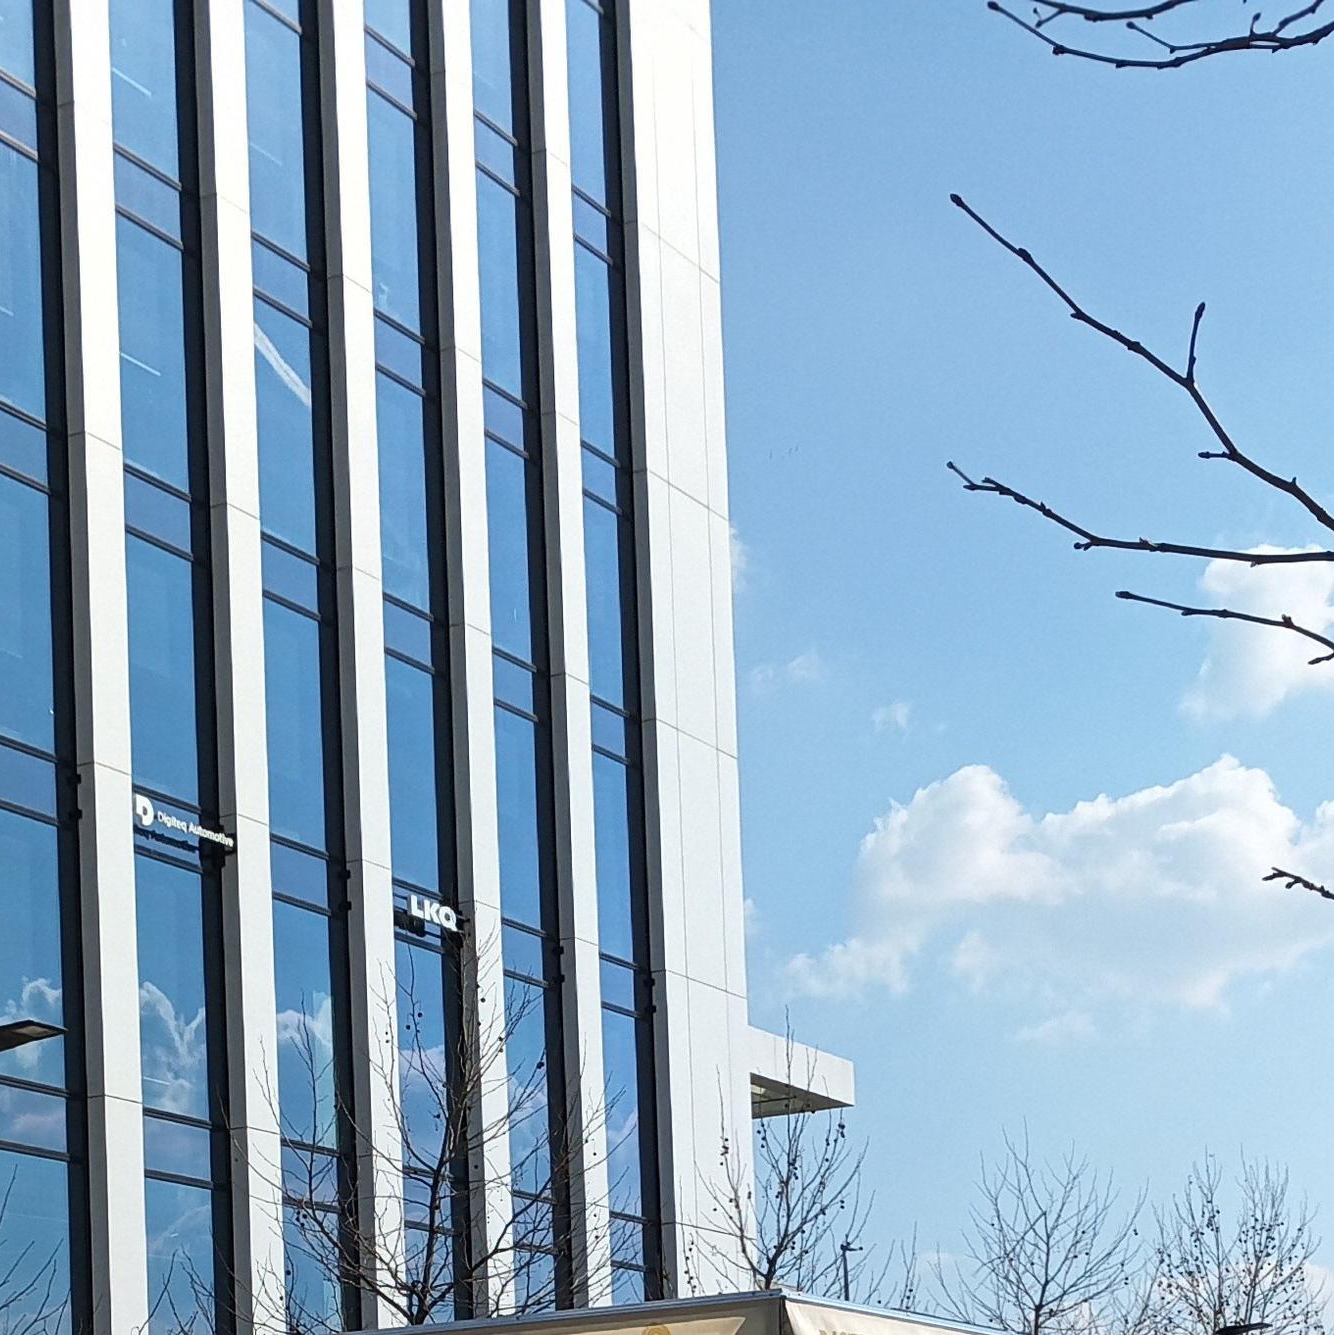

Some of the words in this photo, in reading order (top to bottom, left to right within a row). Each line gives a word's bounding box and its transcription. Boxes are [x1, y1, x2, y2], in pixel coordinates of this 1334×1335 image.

[157, 811, 187, 833] Digiteq
[188, 822, 234, 848] Automotive
[410, 894, 458, 932] LKQ
